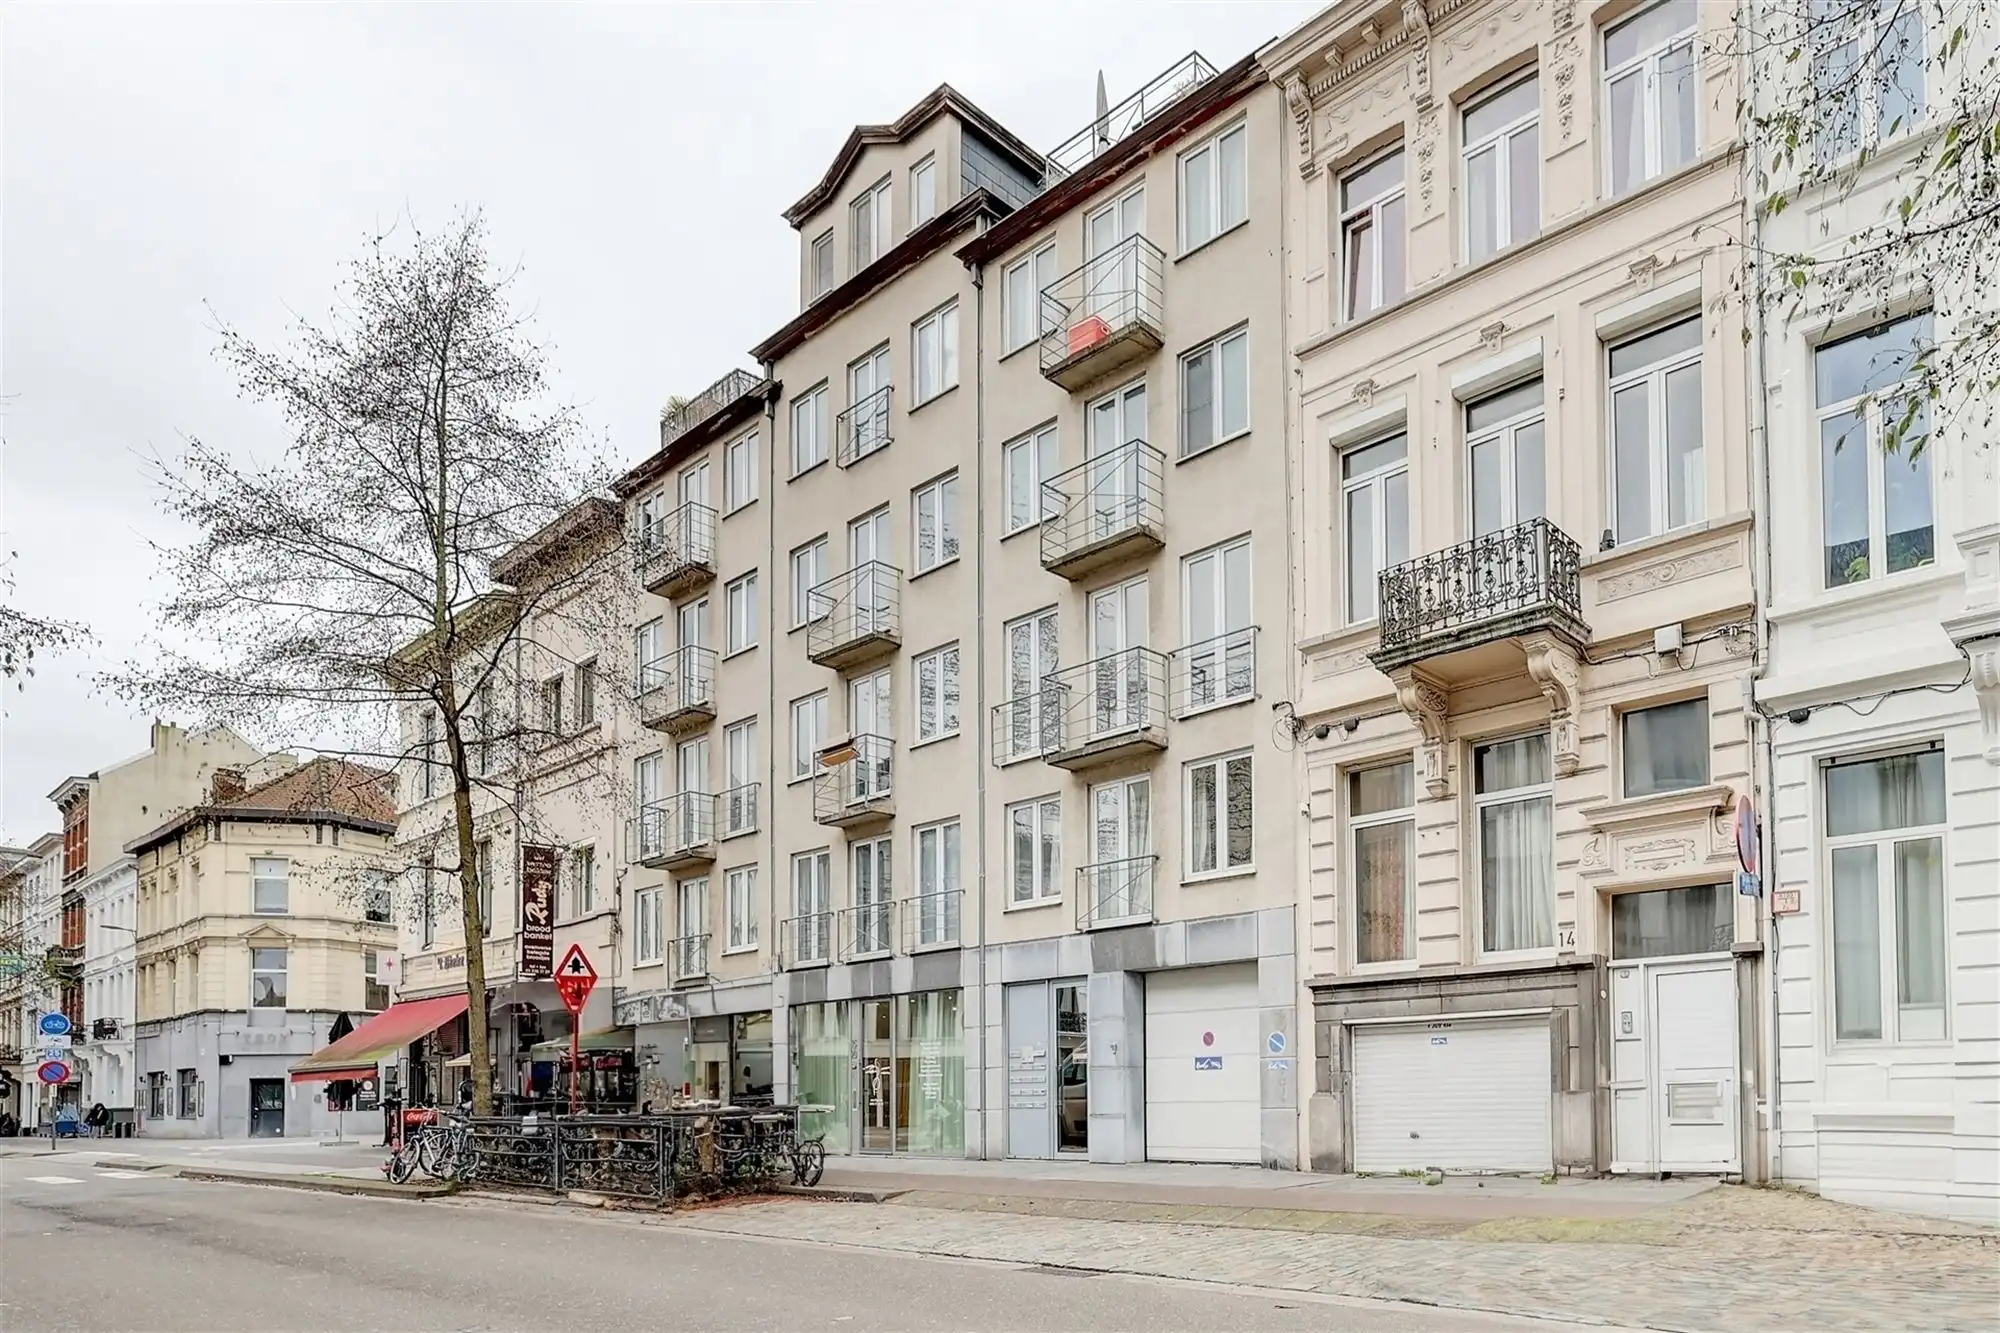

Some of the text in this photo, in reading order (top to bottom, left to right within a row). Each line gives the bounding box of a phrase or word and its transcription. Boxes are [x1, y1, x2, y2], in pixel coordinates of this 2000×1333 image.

[525, 880, 552, 925] Rudy
[526, 923, 551, 933] brood
[524, 930, 552, 941] banket
[1559, 931, 1576, 947] 14
